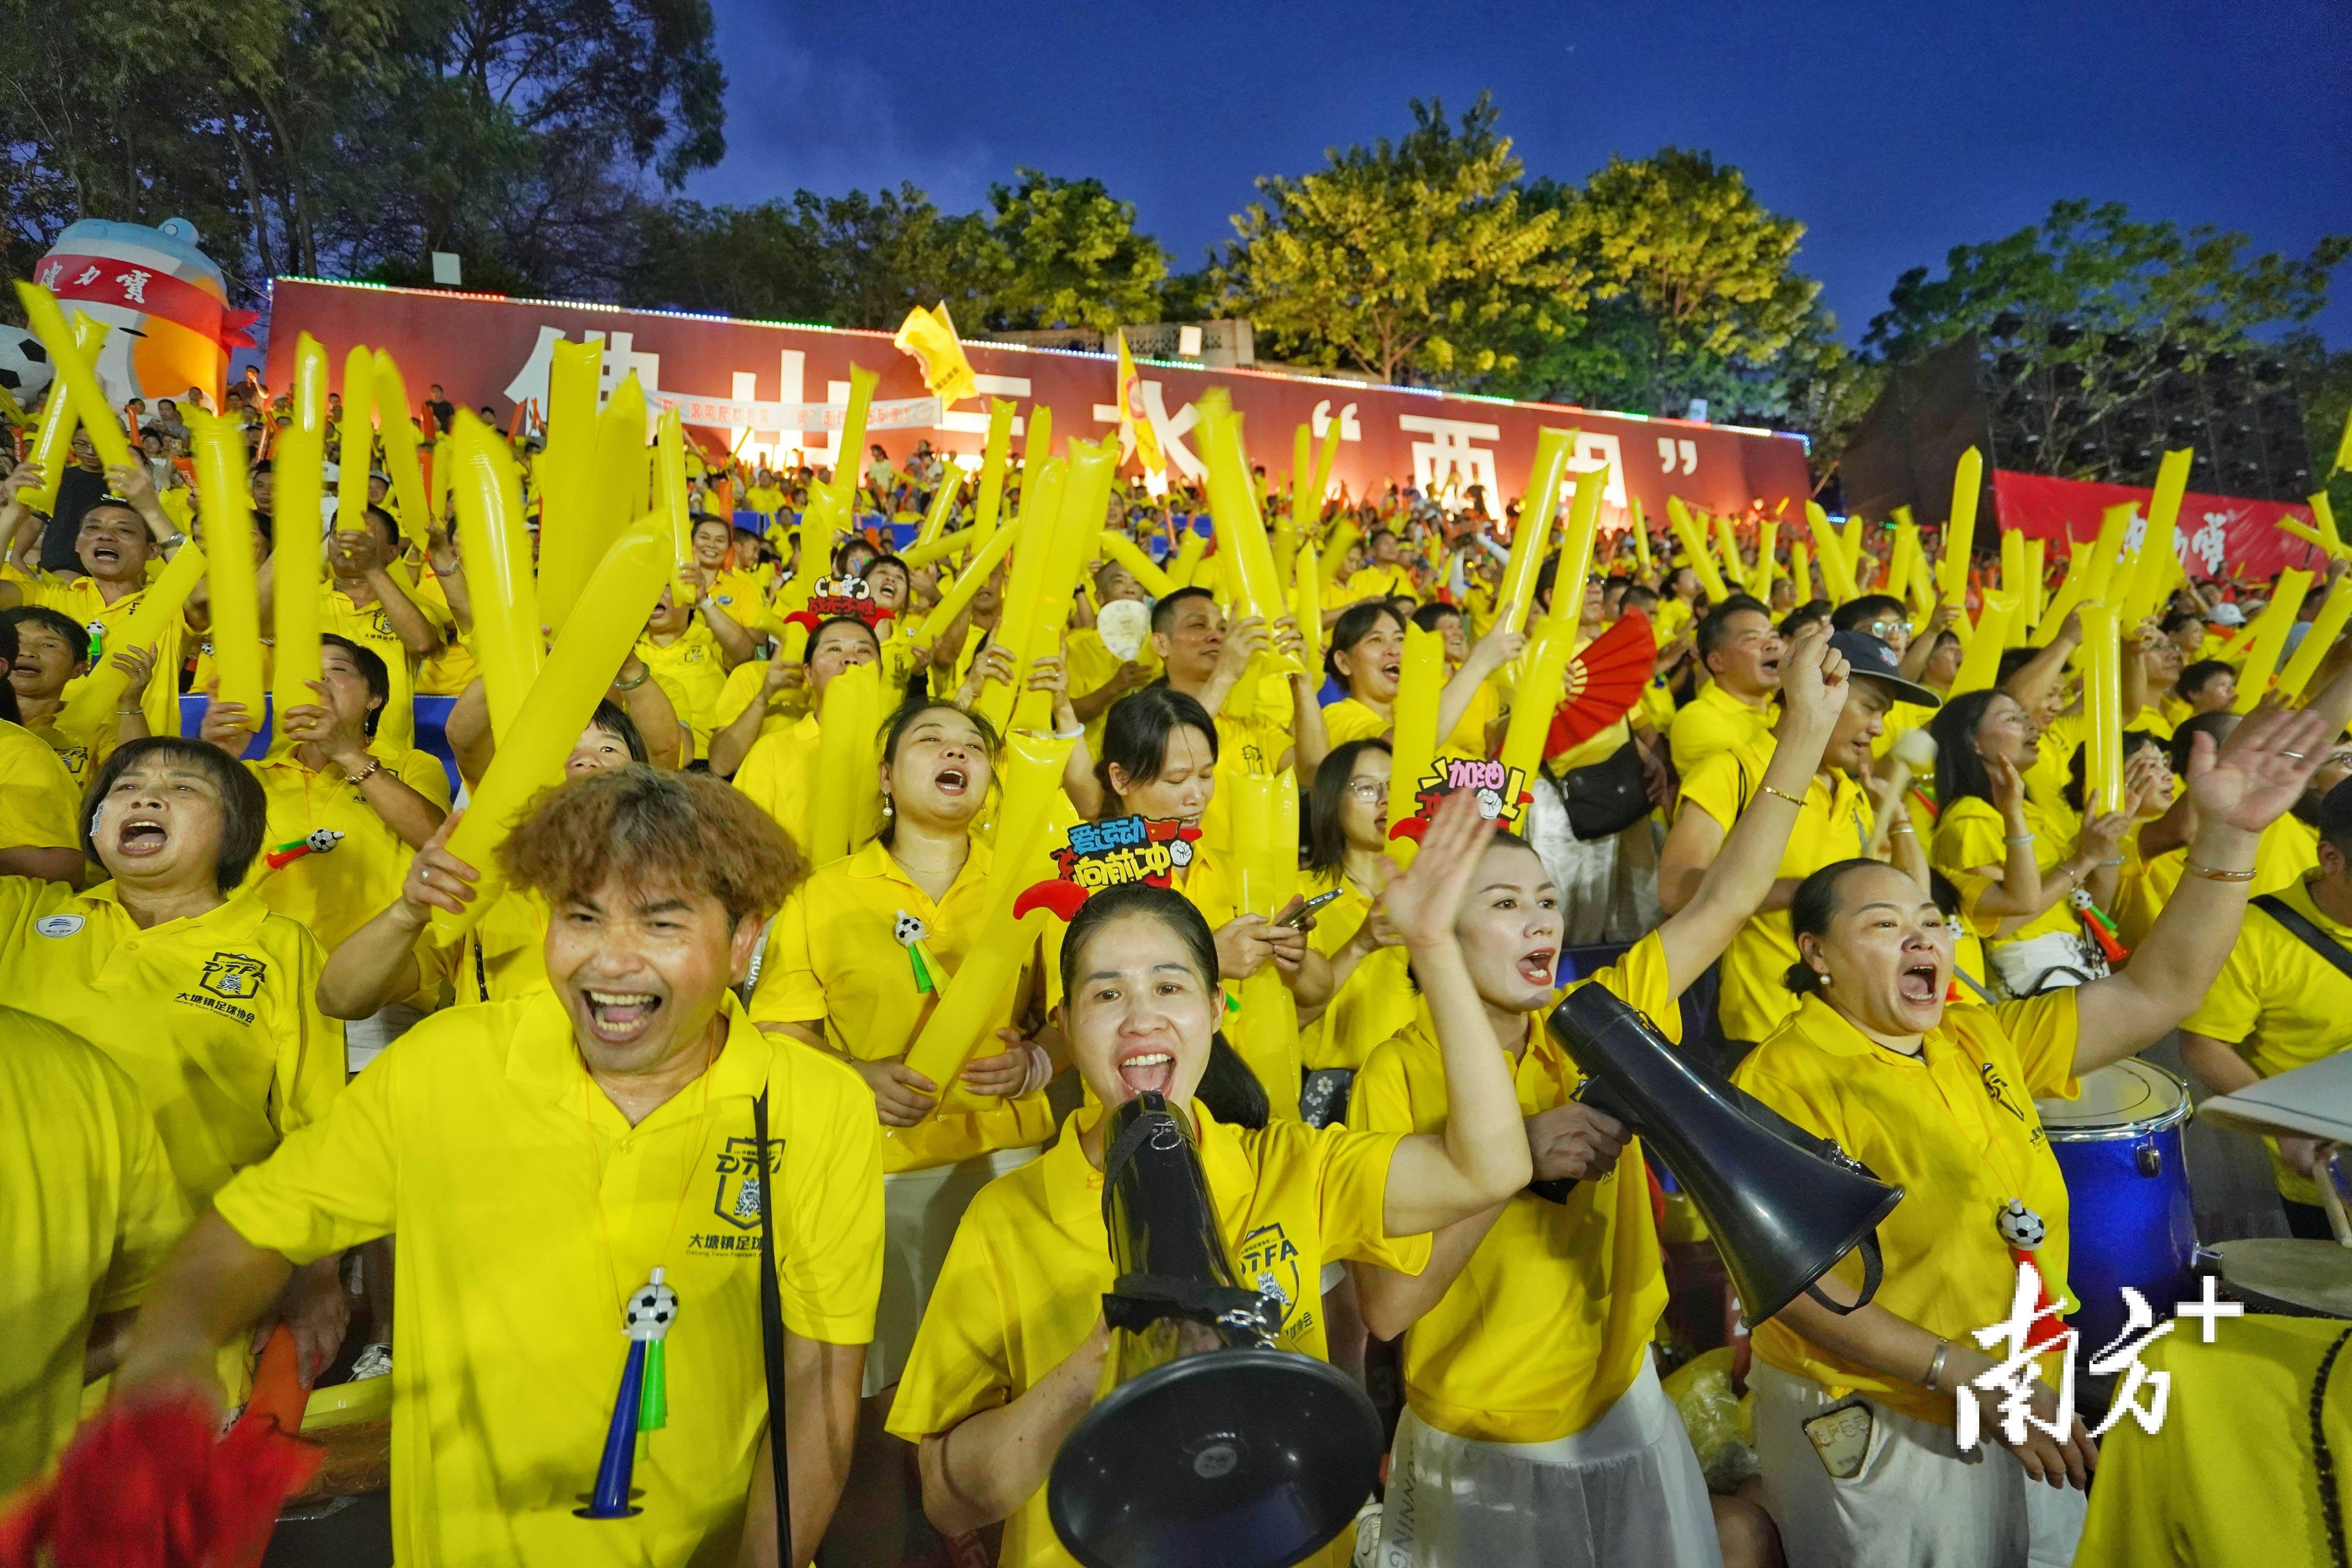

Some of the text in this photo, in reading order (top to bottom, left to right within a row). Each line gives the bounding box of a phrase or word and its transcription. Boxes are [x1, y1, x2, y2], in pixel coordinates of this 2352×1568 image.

[1448, 760, 1504, 789] 加油
[1071, 816, 1146, 855] 爱运动
[1073, 841, 1171, 888] 向前冲
[202, 961, 265, 983] DTFA
[175, 993, 255, 1024] 大塘镇足球协会
[1388, 1450, 1417, 1568] UNNING
